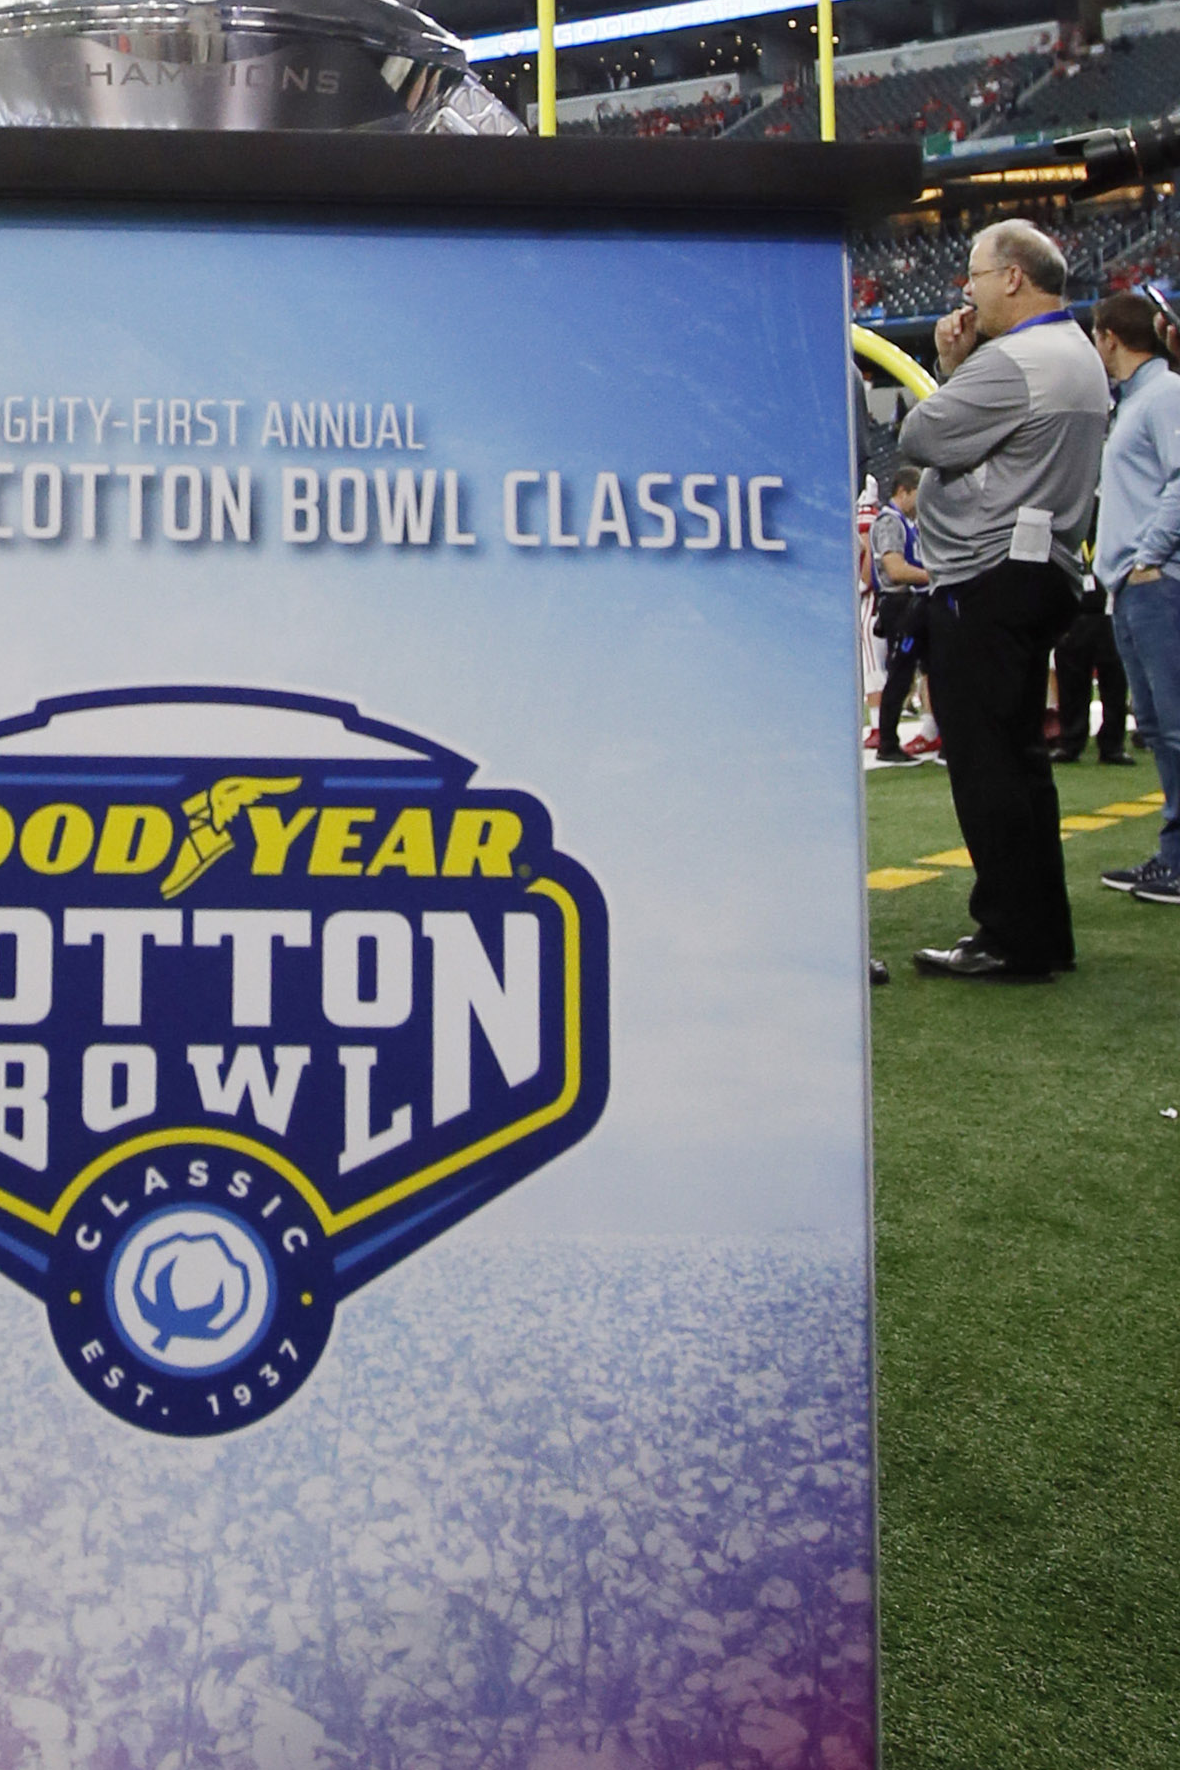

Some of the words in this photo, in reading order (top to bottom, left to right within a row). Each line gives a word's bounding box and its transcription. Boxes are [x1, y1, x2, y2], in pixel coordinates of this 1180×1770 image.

[261, 399, 425, 451] ANNUAL
[281, 468, 476, 548] BOWL
[503, 471, 787, 552] CLASSIC
[75, 1160, 310, 1253] CLASSIC
[79, 1338, 172, 1418] EST.
[205, 1337, 301, 1417] 1937
